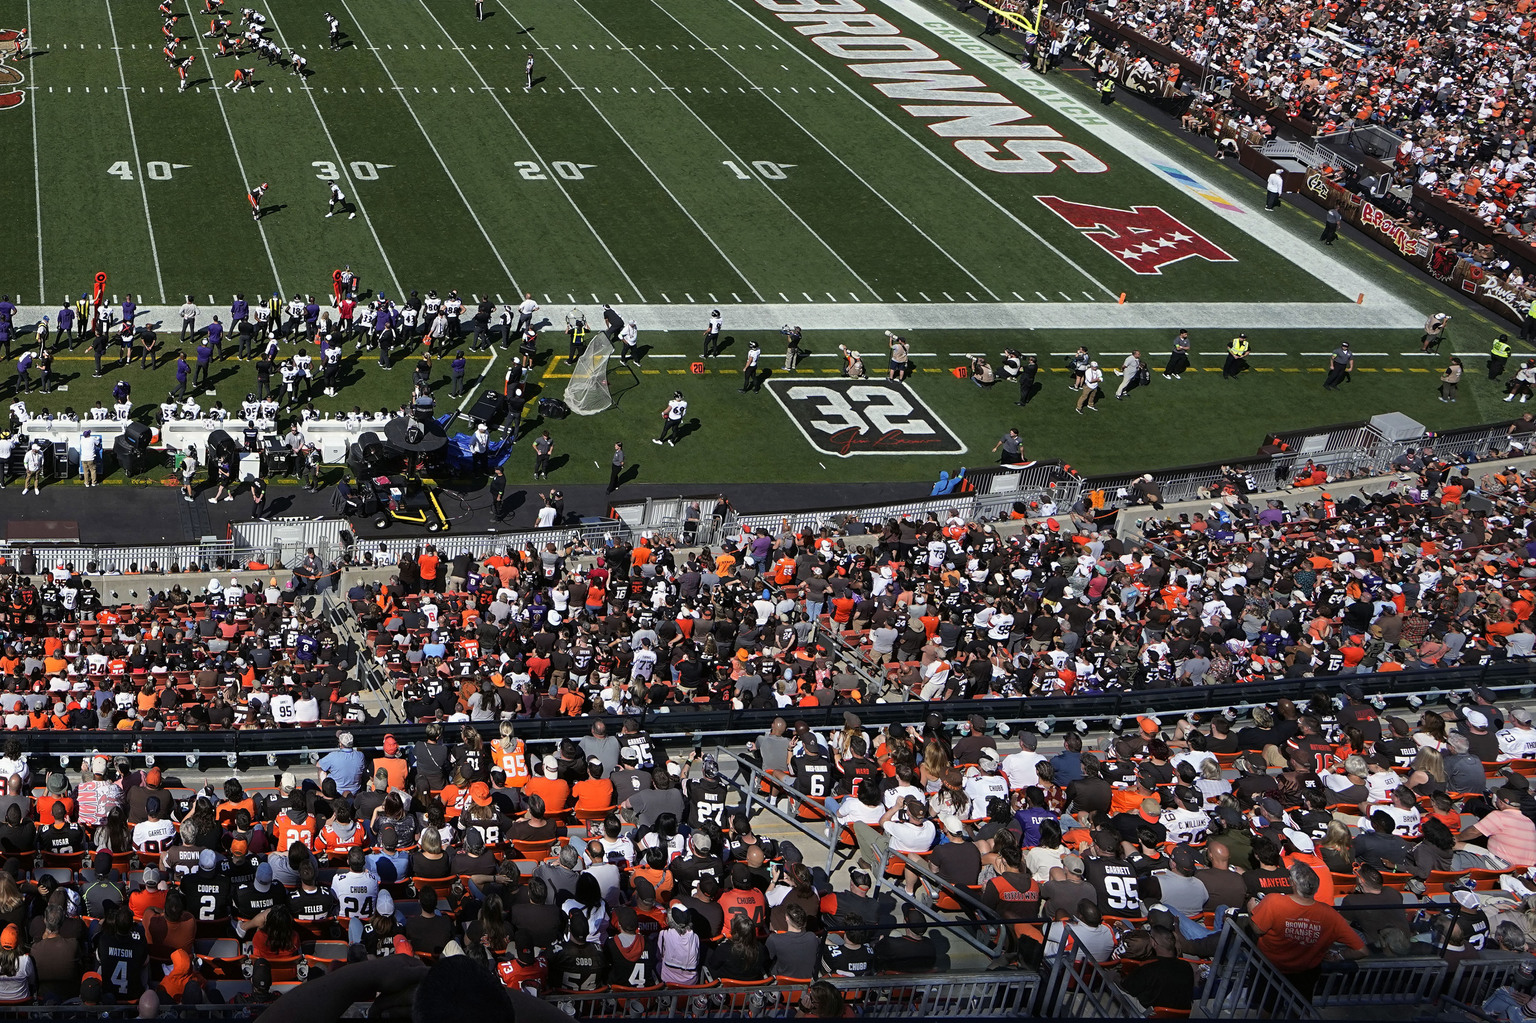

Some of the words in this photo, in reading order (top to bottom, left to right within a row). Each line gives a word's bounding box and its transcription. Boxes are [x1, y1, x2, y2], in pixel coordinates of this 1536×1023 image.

[923, 21, 1021, 71] CRUCIAL
[1016, 76, 1109, 127] CATCH
[107, 161, 174, 181] 40
[311, 160, 381, 181] 30
[514, 160, 585, 180] 20
[721, 160, 788, 180] 10
[1361, 201, 1419, 257] BROWNS
[693, 364, 703, 373] 20
[957, 368, 966, 377] 10
[786, 385, 936, 436] 32
[280, 706, 292, 717] 95
[503, 756, 527, 777] 95
[810, 775, 824, 797] 6
[988, 784, 1004, 793] CHUBB
[180, 851, 199, 861] BROWN
[1104, 865, 1132, 877] GARRETT
[197, 884, 219, 894] COOPER
[351, 886, 368, 895] CHUBB
[1104, 877, 1140, 911] 95
[199, 895, 216, 921] 2
[250, 898, 274, 909] WATSON
[304, 904, 323, 914] TELLER
[108, 946, 133, 959] WATSON
[575, 957, 593, 968] SOBO
[848, 962, 867, 972] CHUBB
[110, 961, 129, 994] 4
[628, 962, 646, 988] 4
